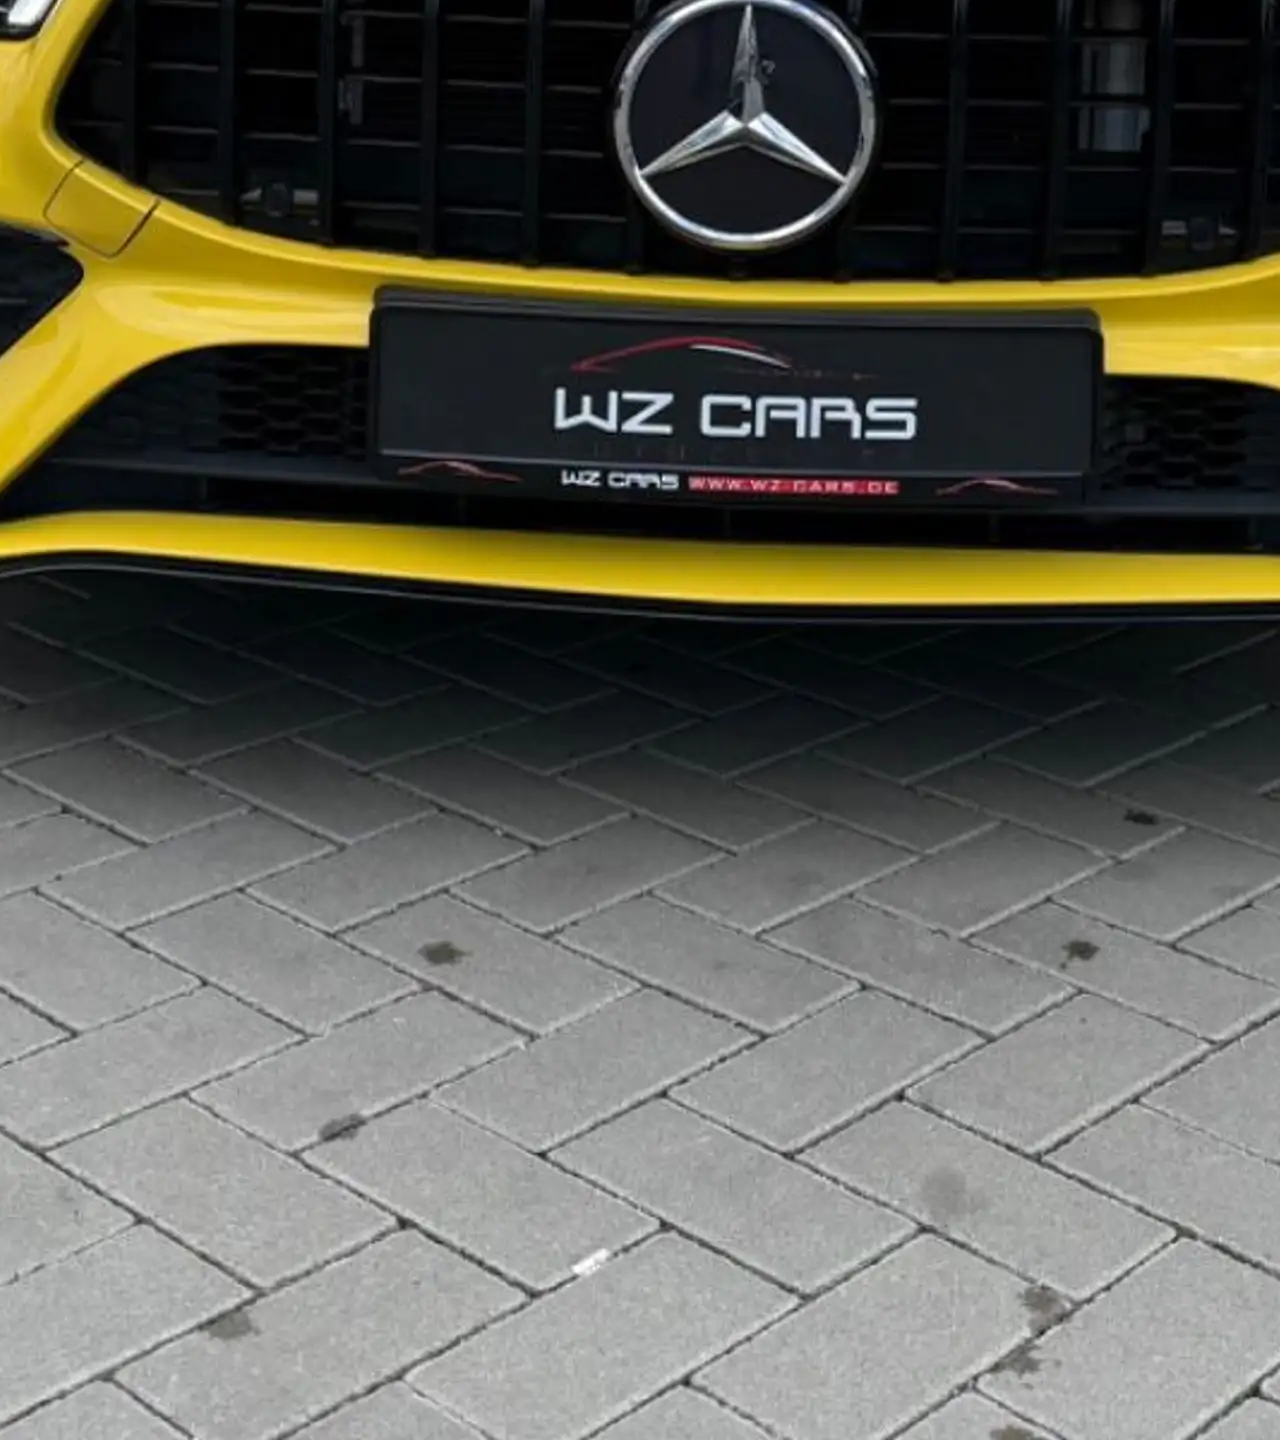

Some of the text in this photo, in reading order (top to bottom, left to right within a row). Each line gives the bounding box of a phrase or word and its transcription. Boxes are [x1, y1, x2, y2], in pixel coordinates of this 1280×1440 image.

[554, 386, 918, 440] WZ CARS
[561, 469, 601, 487] WZ
[607, 471, 680, 490] CARS
